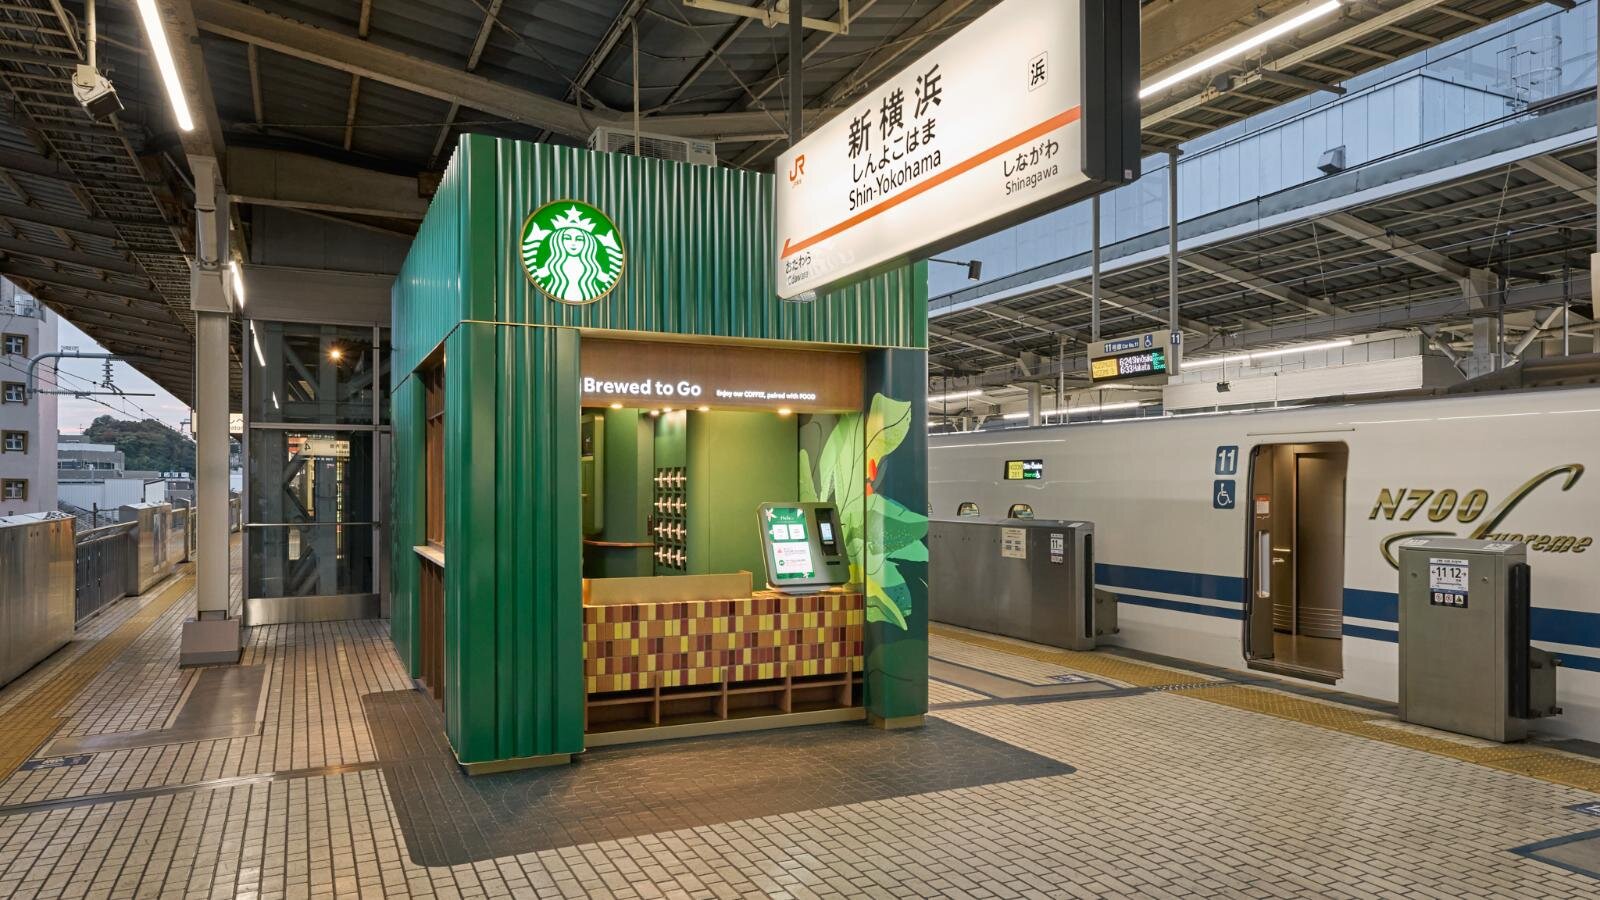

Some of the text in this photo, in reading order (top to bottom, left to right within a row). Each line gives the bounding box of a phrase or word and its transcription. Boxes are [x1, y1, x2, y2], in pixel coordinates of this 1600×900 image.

[1030, 58, 1046, 86] 浜
[848, 63, 943, 159] 新横浜
[853, 118, 936, 183] しんよこはま
[1003, 138, 1059, 178] しながわ
[790, 154, 805, 182] JR
[849, 149, 941, 211] Shin-Yokohama
[1005, 164, 1058, 196] Shinagawa
[1171, 333, 1180, 344] 11
[583, 377, 702, 397] Brewed to Go
[716, 389, 733, 398] Enjoy
[767, 392, 785, 400] paired
[1218, 449, 1236, 472] 11
[1368, 487, 1489, 523] N700
[1436, 566, 1462, 579] 11 12
